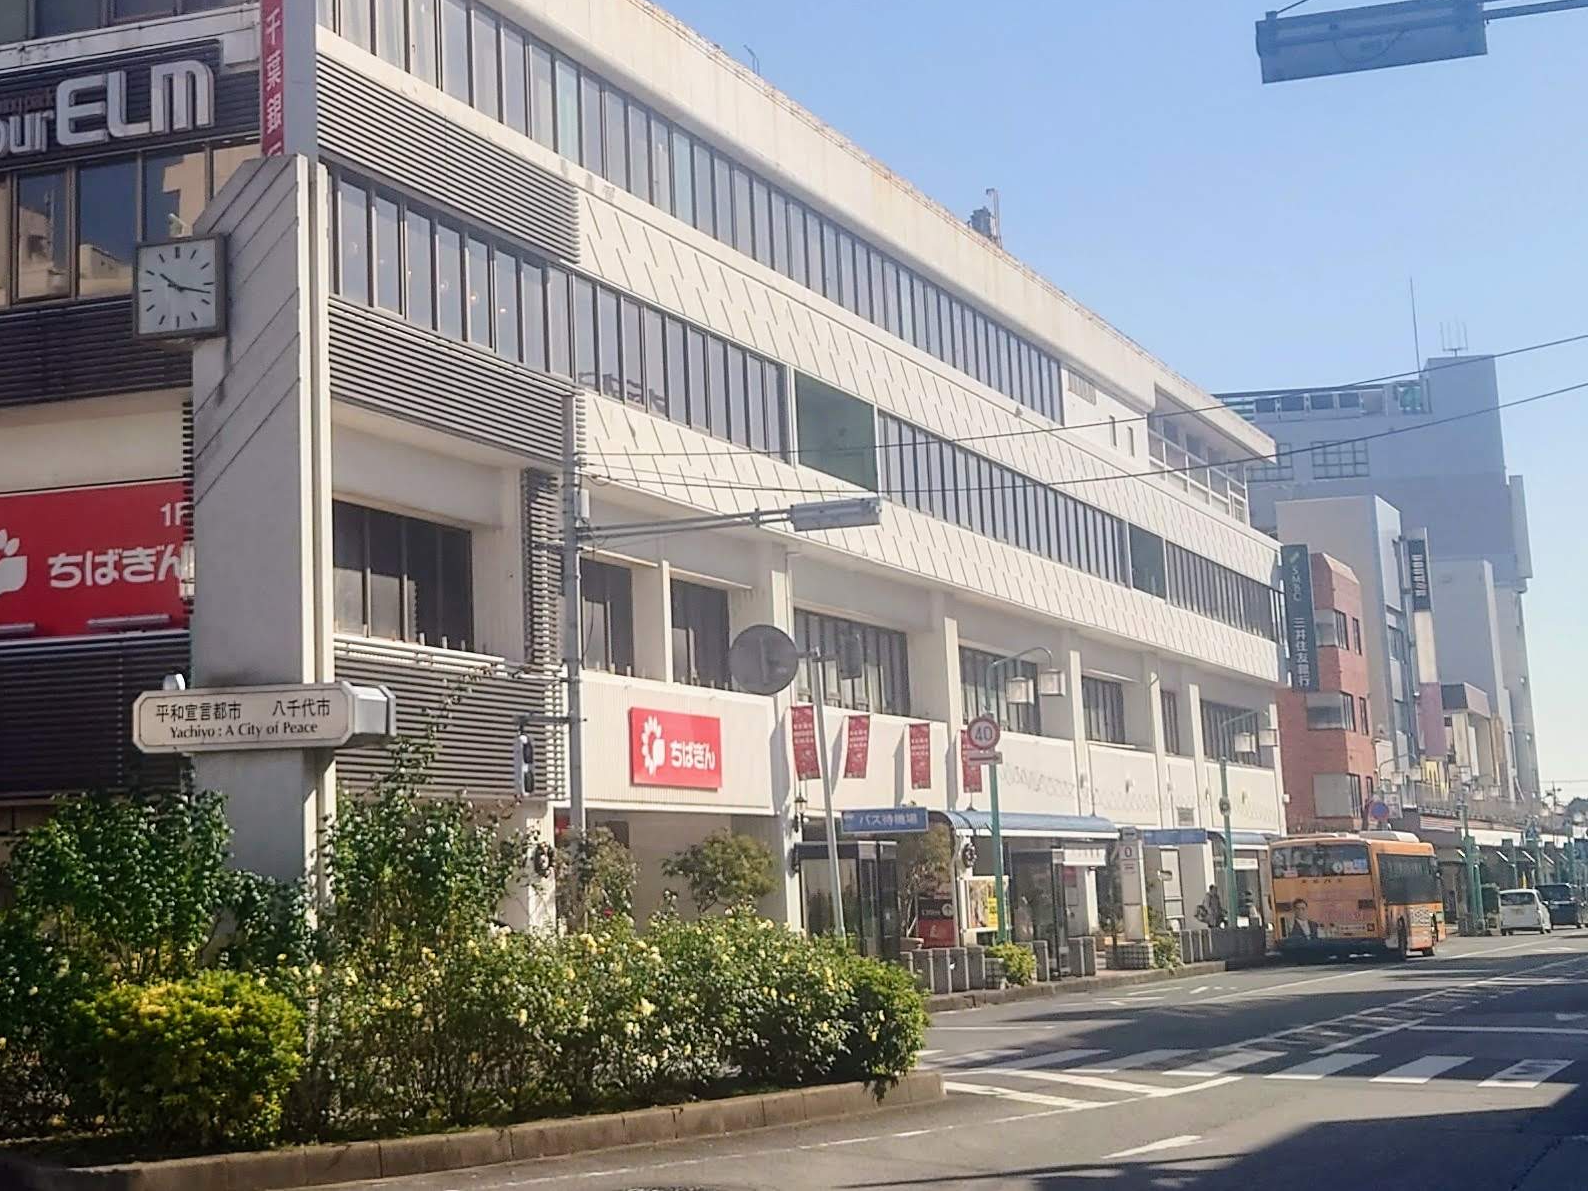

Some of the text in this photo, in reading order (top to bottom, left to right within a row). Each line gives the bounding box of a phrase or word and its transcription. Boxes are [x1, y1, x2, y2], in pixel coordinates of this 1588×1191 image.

[265, 6, 284, 157] 千葉銀
[155, 697, 331, 723] 平和宣言都市 八千代市
[169, 724, 215, 740] Yachiyo
[225, 723, 235, 737] A
[238, 721, 262, 740] City
[267, 721, 280, 735] of
[283, 720, 318, 734] Peace
[974, 725, 993, 741] 40
[670, 740, 716, 770] ちばぎん
